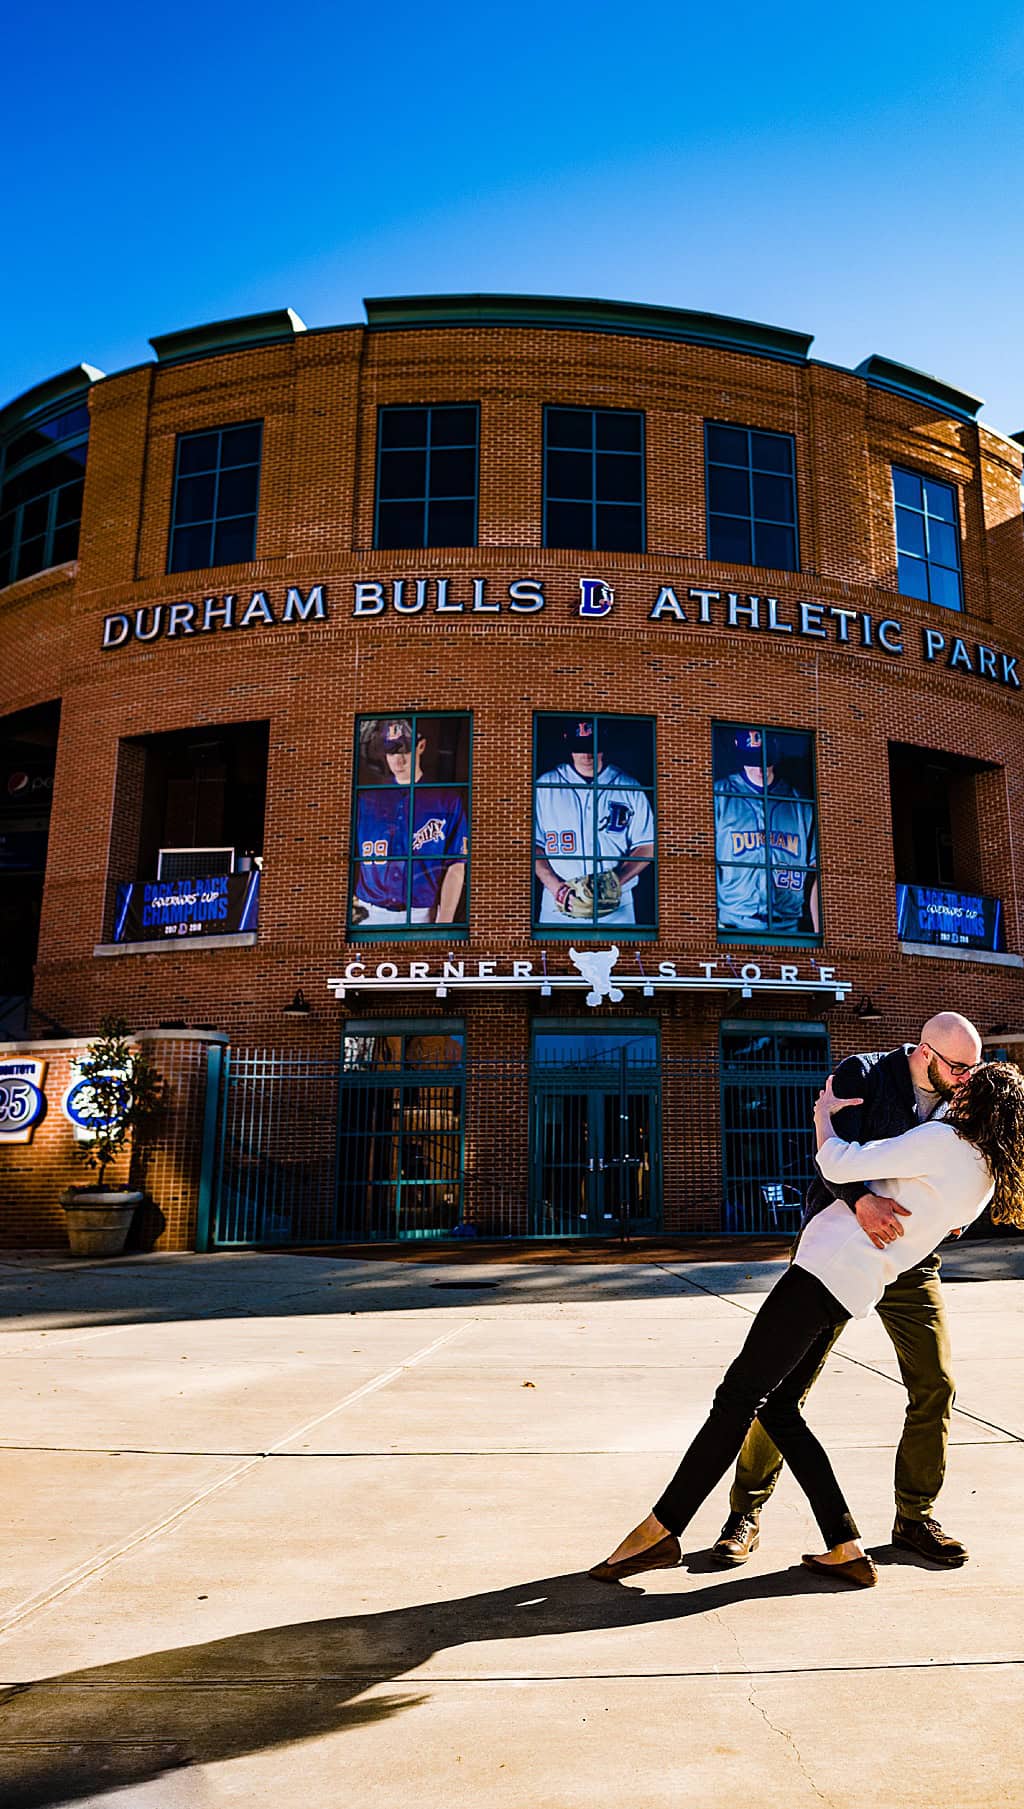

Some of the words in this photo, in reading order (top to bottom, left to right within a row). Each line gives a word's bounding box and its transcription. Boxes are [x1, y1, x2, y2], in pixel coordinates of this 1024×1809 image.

[102, 584, 326, 648] DURHAM
[352, 578, 546, 617] BULLS
[580, 578, 615, 617] D
[649, 586, 904, 653] ATHLETIC
[922, 627, 1022, 688] PARK
[362, 839, 388, 864] 29
[546, 831, 577, 855] 29
[775, 868, 804, 890] 29
[201, 892, 219, 903] CUP
[143, 898, 228, 927] CHAMPIONS
[344, 961, 534, 980] CORNER
[658, 961, 836, 983] STORE
